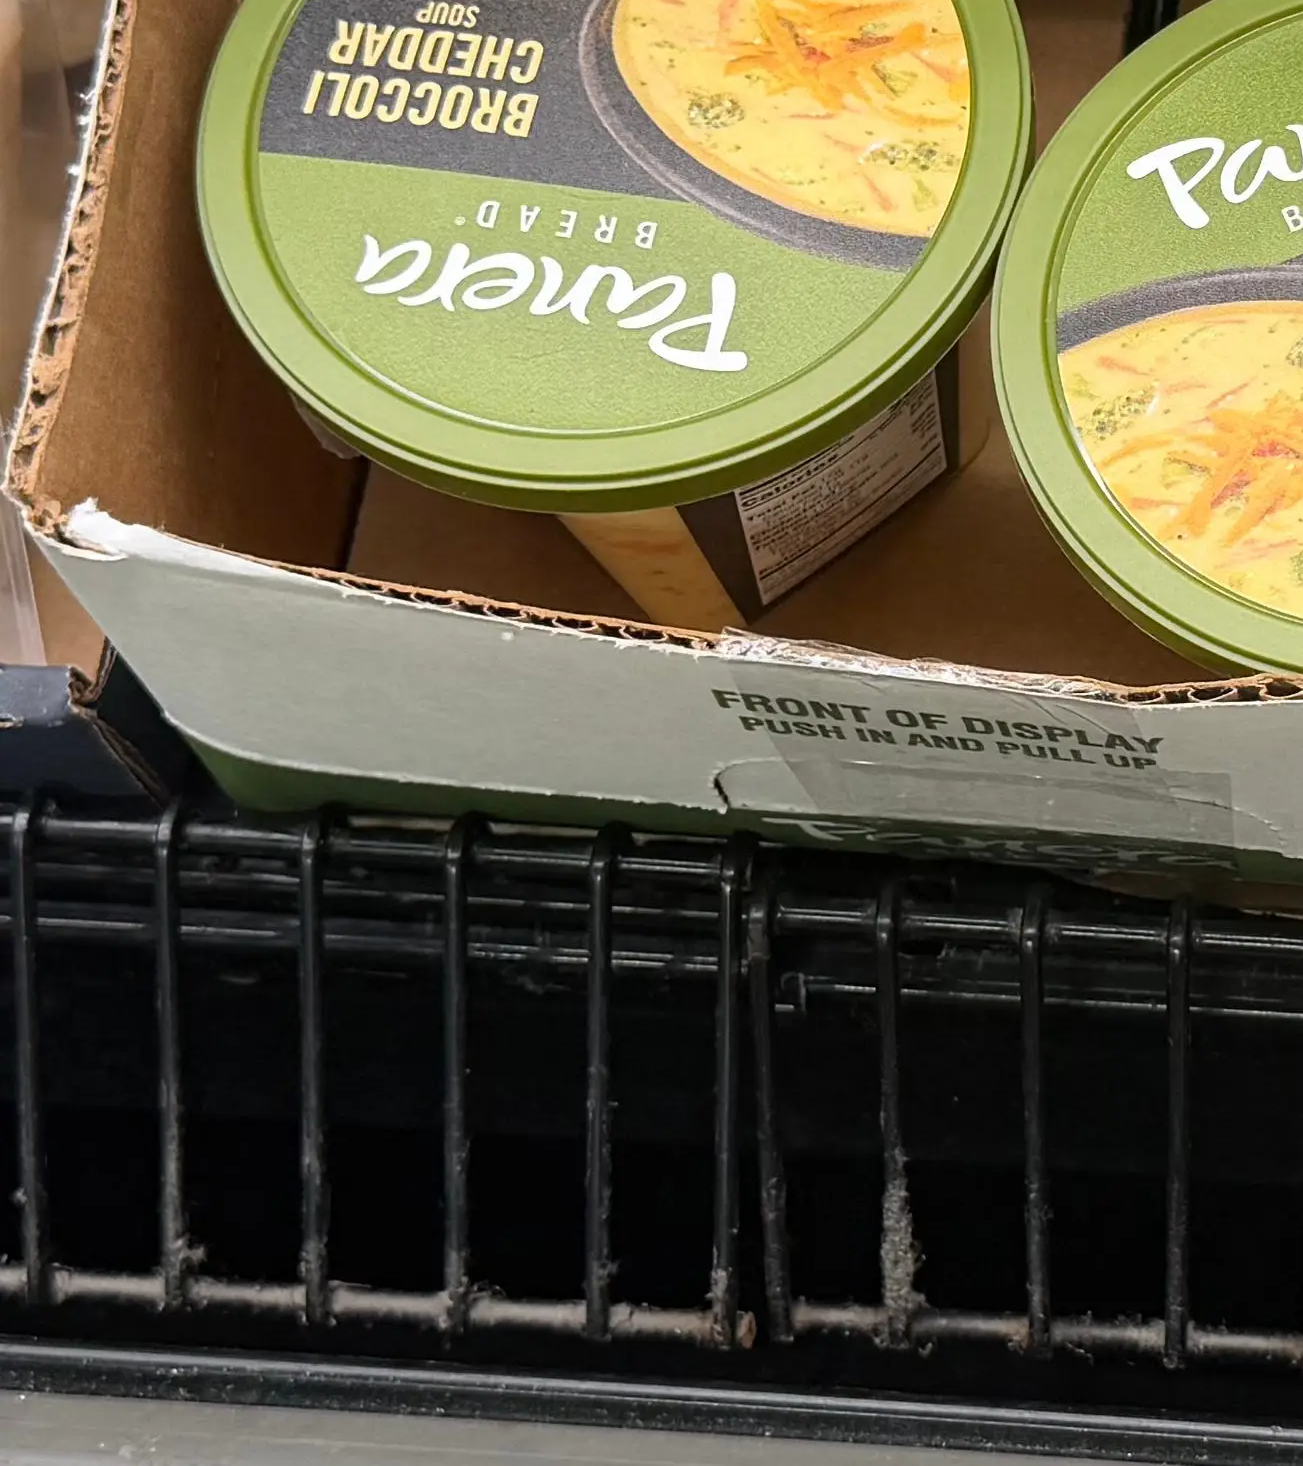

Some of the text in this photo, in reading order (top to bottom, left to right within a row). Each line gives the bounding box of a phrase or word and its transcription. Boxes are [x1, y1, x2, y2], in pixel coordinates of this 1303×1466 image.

[415, 0, 480, 26] SOUP
[328, 20, 544, 85] CHEDDAR
[302, 70, 540, 138] BROCCOLI
[357, 233, 748, 373] Panera
[710, 688, 1163, 755] FRONT OF DISPLAY
[738, 715, 1157, 772] PUSH IN AND PULL UP
